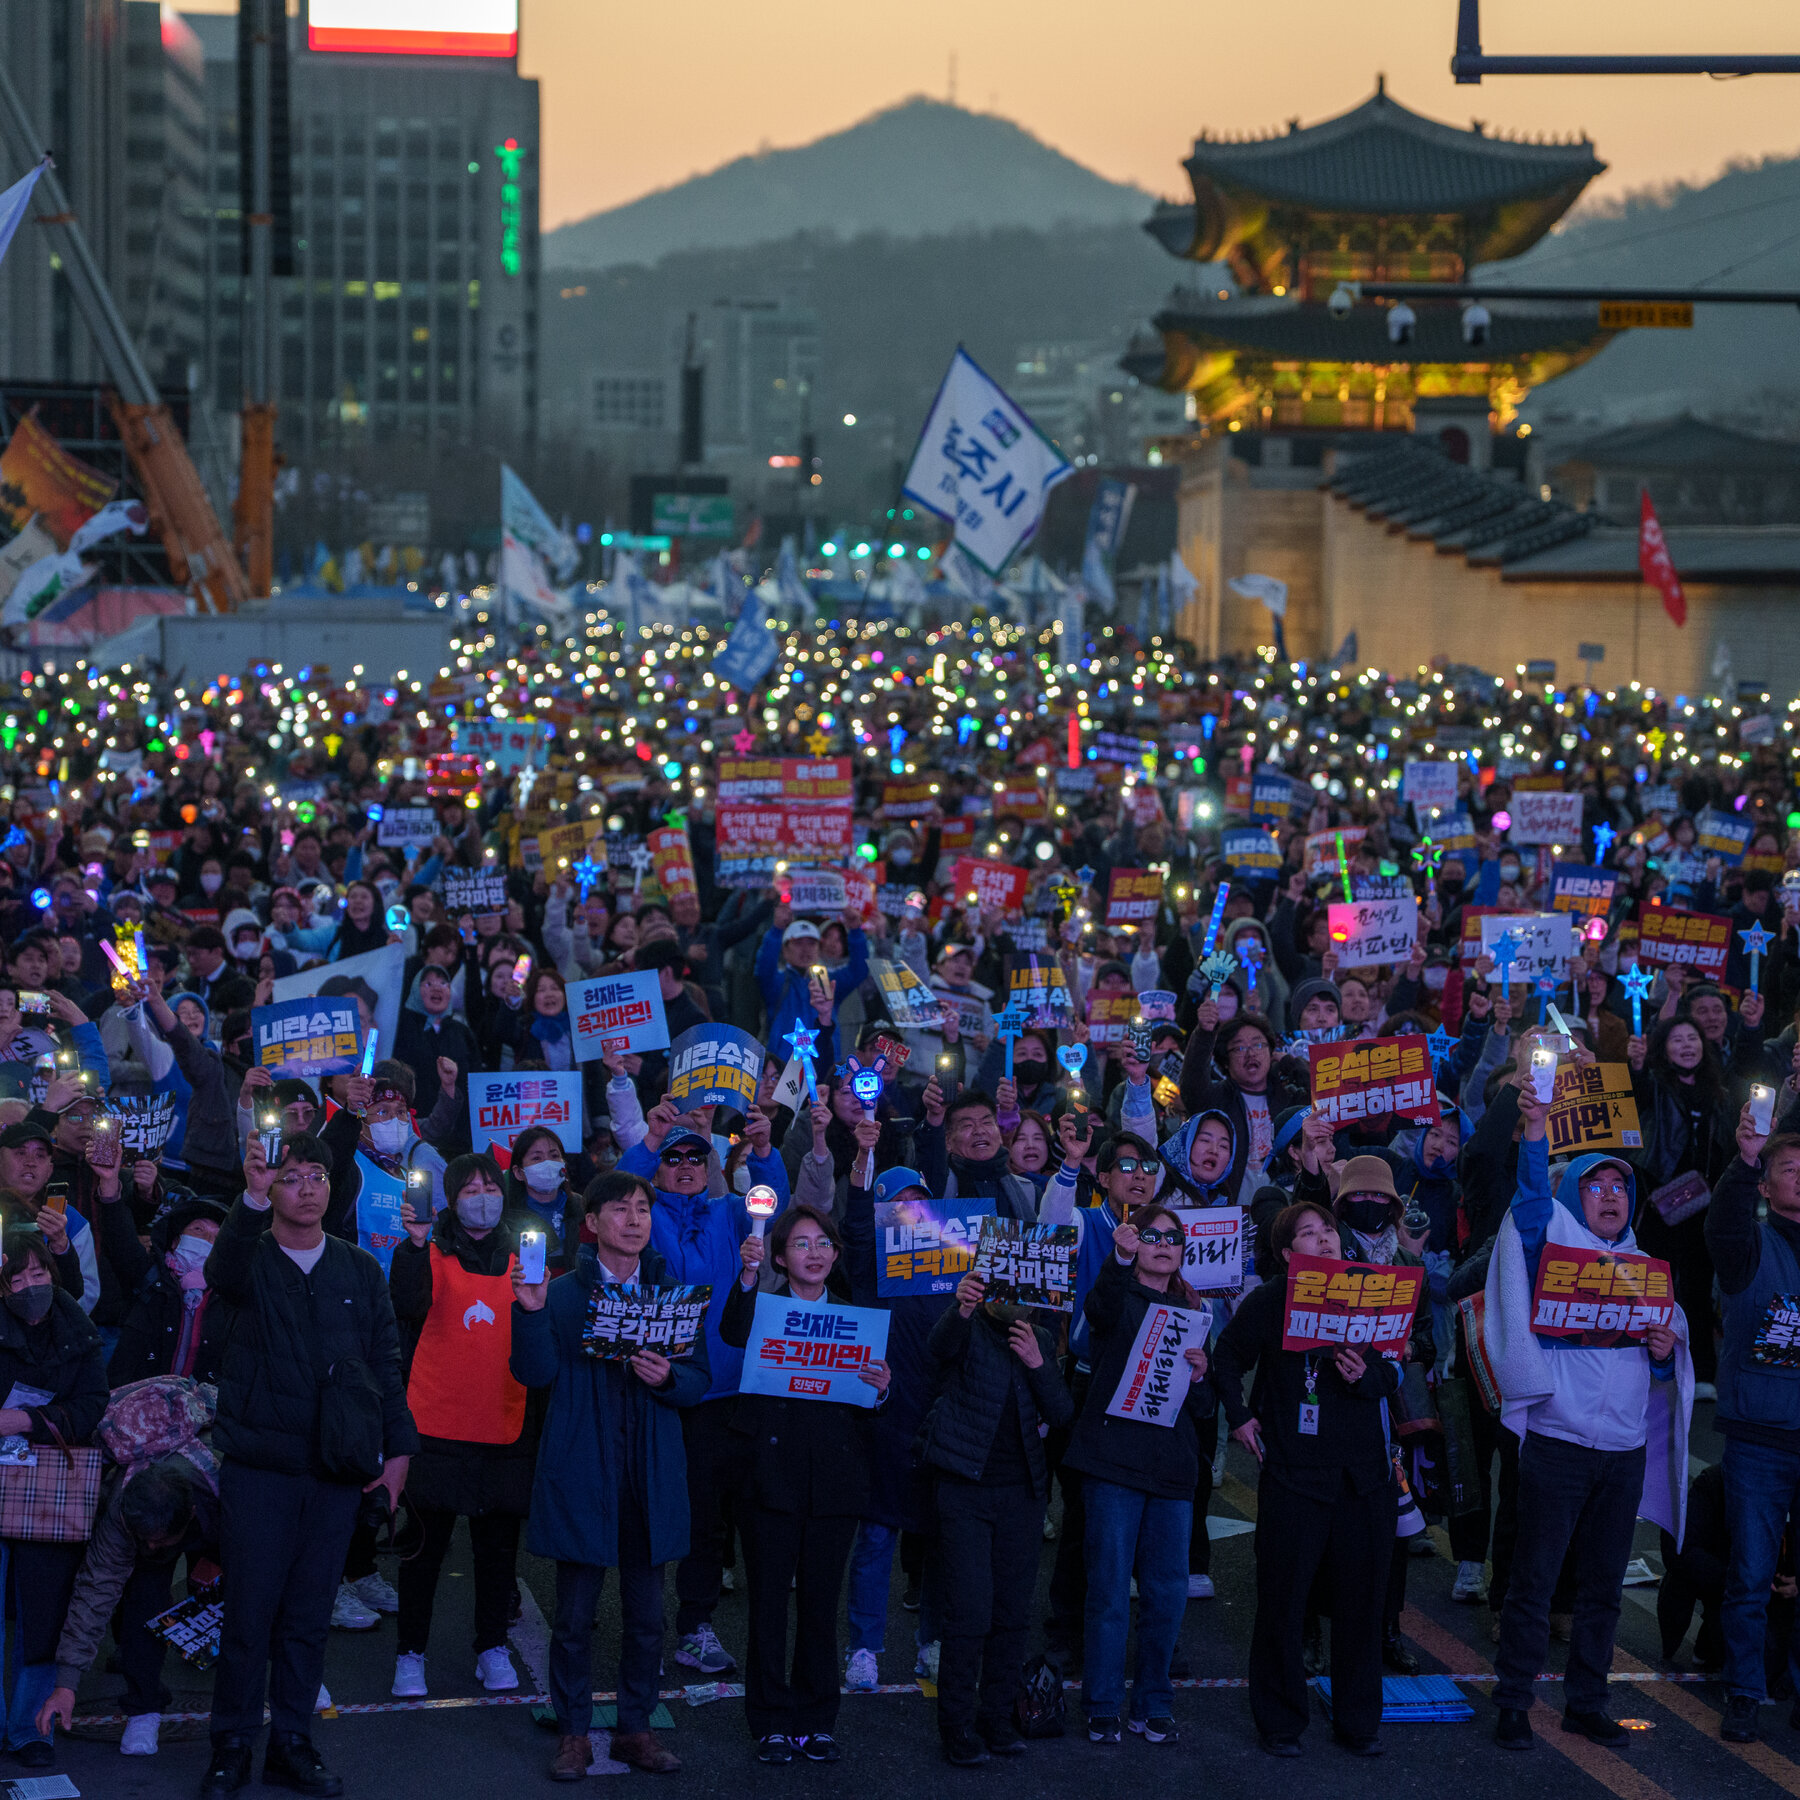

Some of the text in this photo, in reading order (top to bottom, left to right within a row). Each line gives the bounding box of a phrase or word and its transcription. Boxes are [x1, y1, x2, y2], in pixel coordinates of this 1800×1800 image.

[1642, 913, 1727, 944] 윤석열을
[1640, 938, 1729, 968] 파면하라!
[583, 982, 635, 1011] 헌재는
[260, 1010, 355, 1047] 내란수괴
[576, 1000, 653, 1034] 즉각파면!
[1001, 1020, 1021, 1031] 파면
[261, 1033, 358, 1067] 즉각파면
[671, 1040, 760, 1080] 내란수괴
[1315, 1043, 1425, 1092] 윤석열을
[485, 1079, 559, 1103] 윤석열은
[670, 1065, 757, 1104] 즉각파면
[703, 1093, 726, 1103] 민주당
[1316, 1078, 1432, 1123] 파면하라!
[478, 1100, 570, 1128] 다시구속!
[1548, 1102, 1613, 1151] 파면
[120, 1123, 169, 1153] 각파면
[886, 1244, 976, 1280] 즉각파
[980, 1236, 1071, 1263] 내란수괴 윤석열
[931, 1283, 953, 1291] 민주당
[973, 1254, 1069, 1292] 즉각파면
[1293, 1270, 1417, 1307] 윤석열을
[1543, 1260, 1669, 1298] 윤석열을
[597, 1300, 703, 1319] 내란수괴 윤석열
[783, 1310, 858, 1341] 헌재는
[1533, 1298, 1673, 1332] 파면하라!
[592, 1315, 699, 1346] 즉각파면
[1287, 1310, 1414, 1344] 파면하라!
[760, 1337, 871, 1370] 즉각파면!
[1140, 1311, 1191, 1419] 해체하라!
[792, 1378, 827, 1392] 진보당
